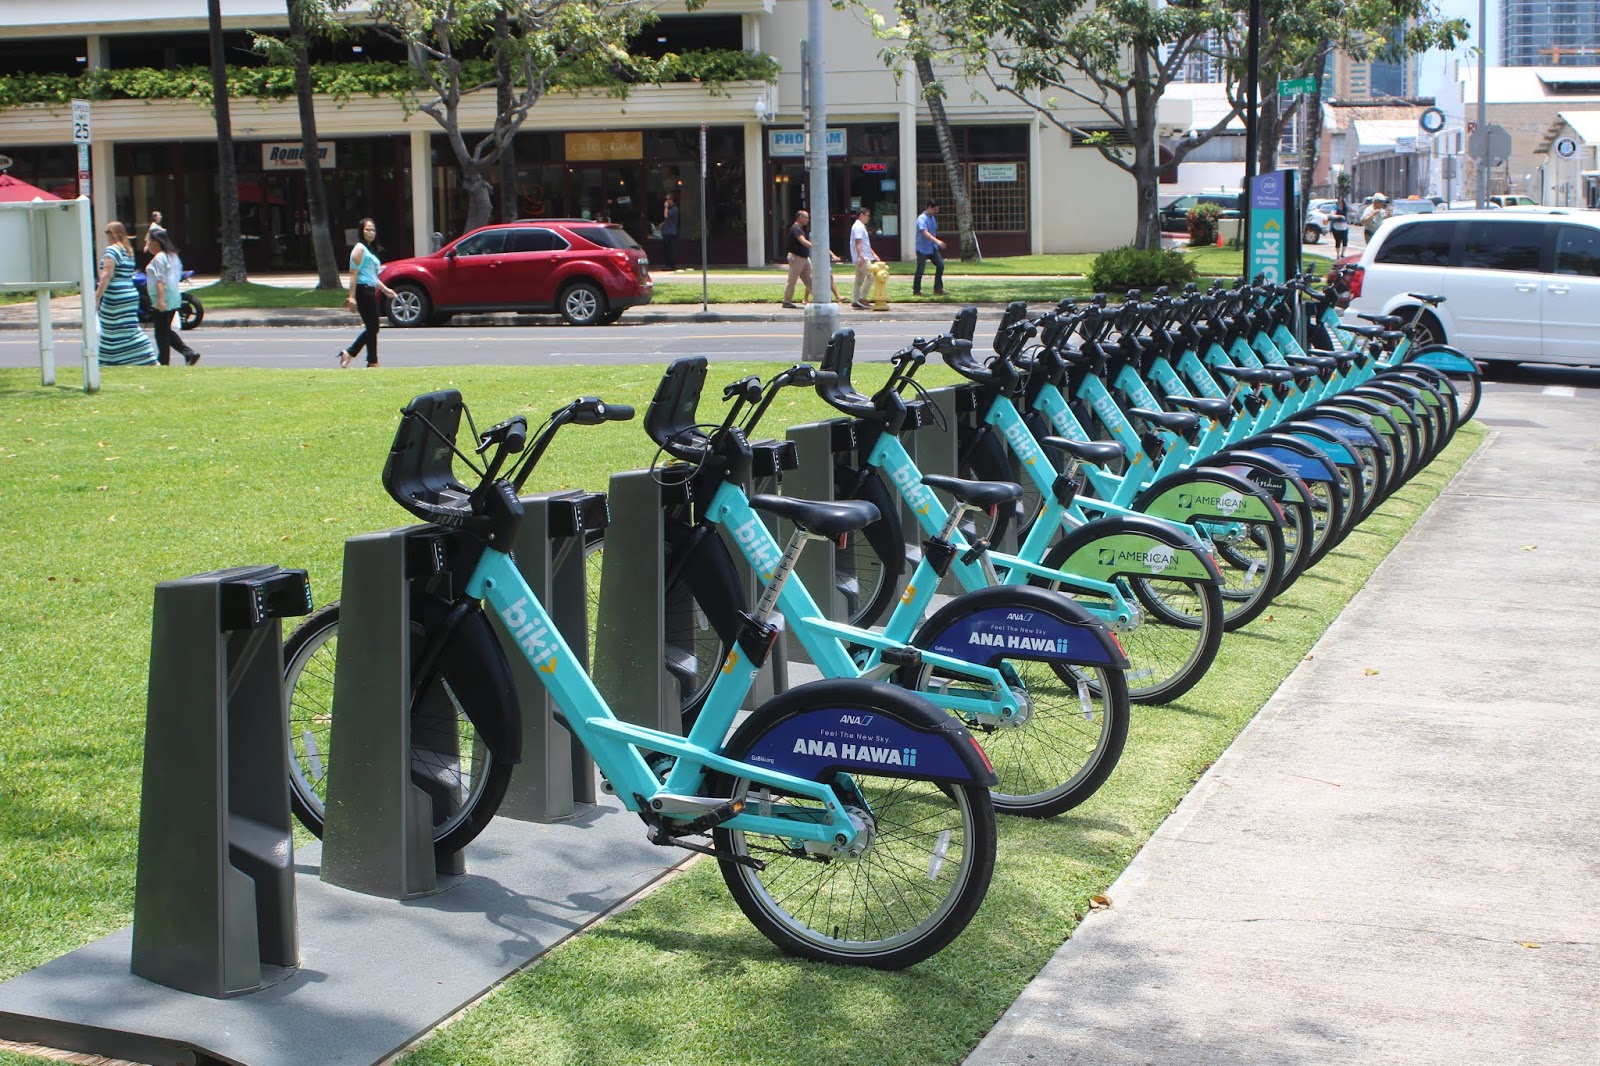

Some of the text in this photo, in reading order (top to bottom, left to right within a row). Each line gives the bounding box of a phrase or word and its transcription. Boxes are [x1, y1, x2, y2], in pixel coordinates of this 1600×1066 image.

[73, 104, 89, 113] SPEED
[75, 123, 89, 139] 25
[862, 163, 886, 171] OPEN
[1094, 395, 1123, 428] biki
[1005, 421, 1037, 460] biki
[892, 463, 931, 508] biki
[1194, 496, 1247, 509] AMERICAN
[734, 518, 780, 573] biki
[1118, 551, 1179, 565] AMERICAN
[1006, 612, 1024, 621] ANA
[501, 596, 559, 665] biki
[968, 631, 1005, 648] ANA
[840, 714, 862, 725] ANA
[820, 728, 838, 737] Feel
[840, 730, 854, 739] The
[856, 732, 874, 741] New
[792, 738, 838, 758] ANA
